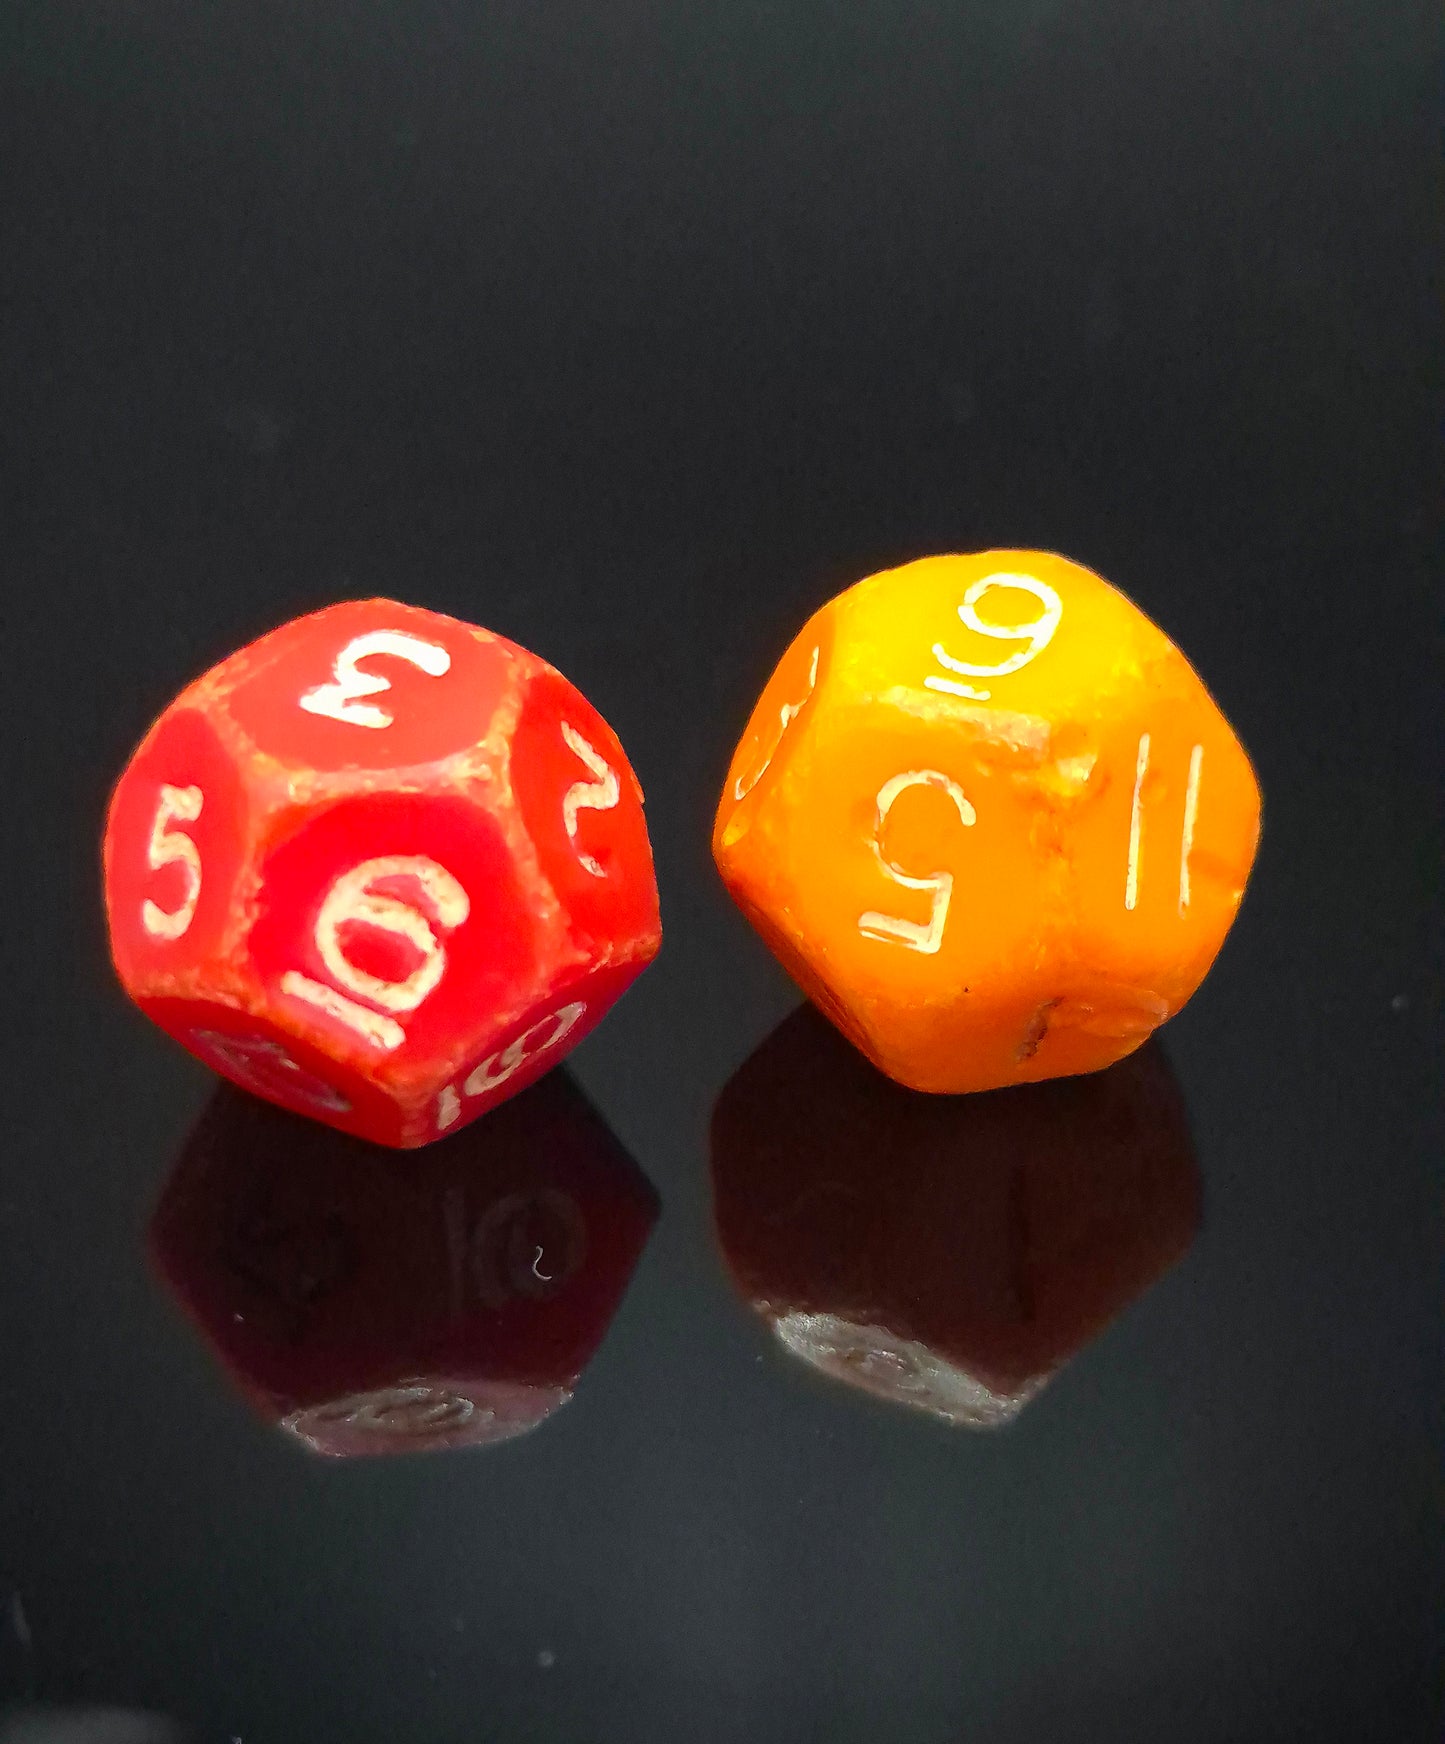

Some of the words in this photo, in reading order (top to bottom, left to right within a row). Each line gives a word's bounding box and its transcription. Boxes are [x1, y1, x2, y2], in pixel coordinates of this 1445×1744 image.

[298, 630, 451, 730] 3
[142, 782, 203, 940] 5
[858, 768, 977, 954] 5
[1124, 732, 1204, 919] 11
